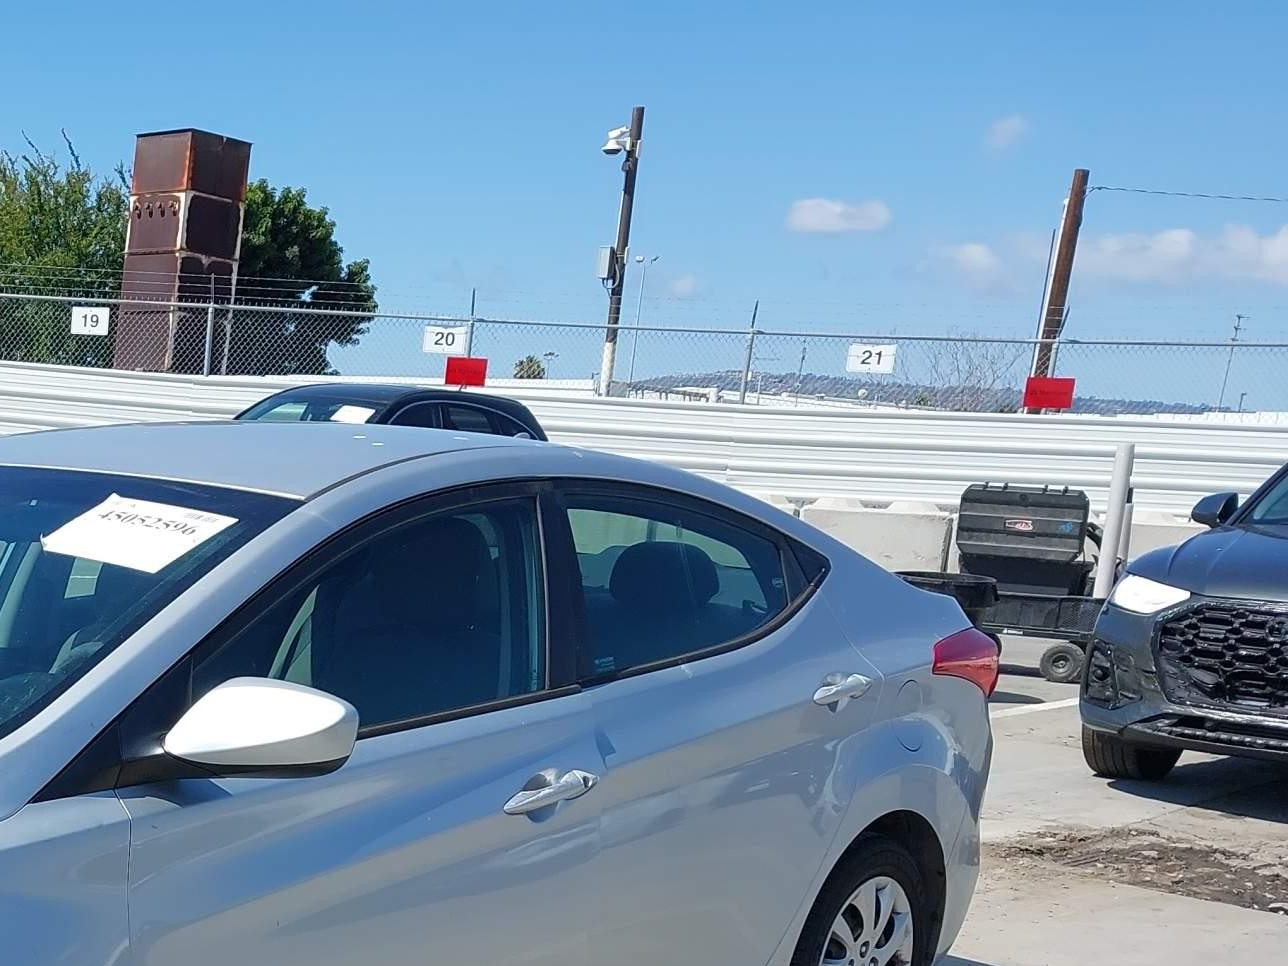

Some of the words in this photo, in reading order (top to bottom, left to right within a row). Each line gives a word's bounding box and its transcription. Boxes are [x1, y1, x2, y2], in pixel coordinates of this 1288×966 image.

[81, 313, 100, 328] 19
[433, 331, 456, 347] 20
[860, 349, 883, 366] 21
[98, 510, 197, 536] 45052596
